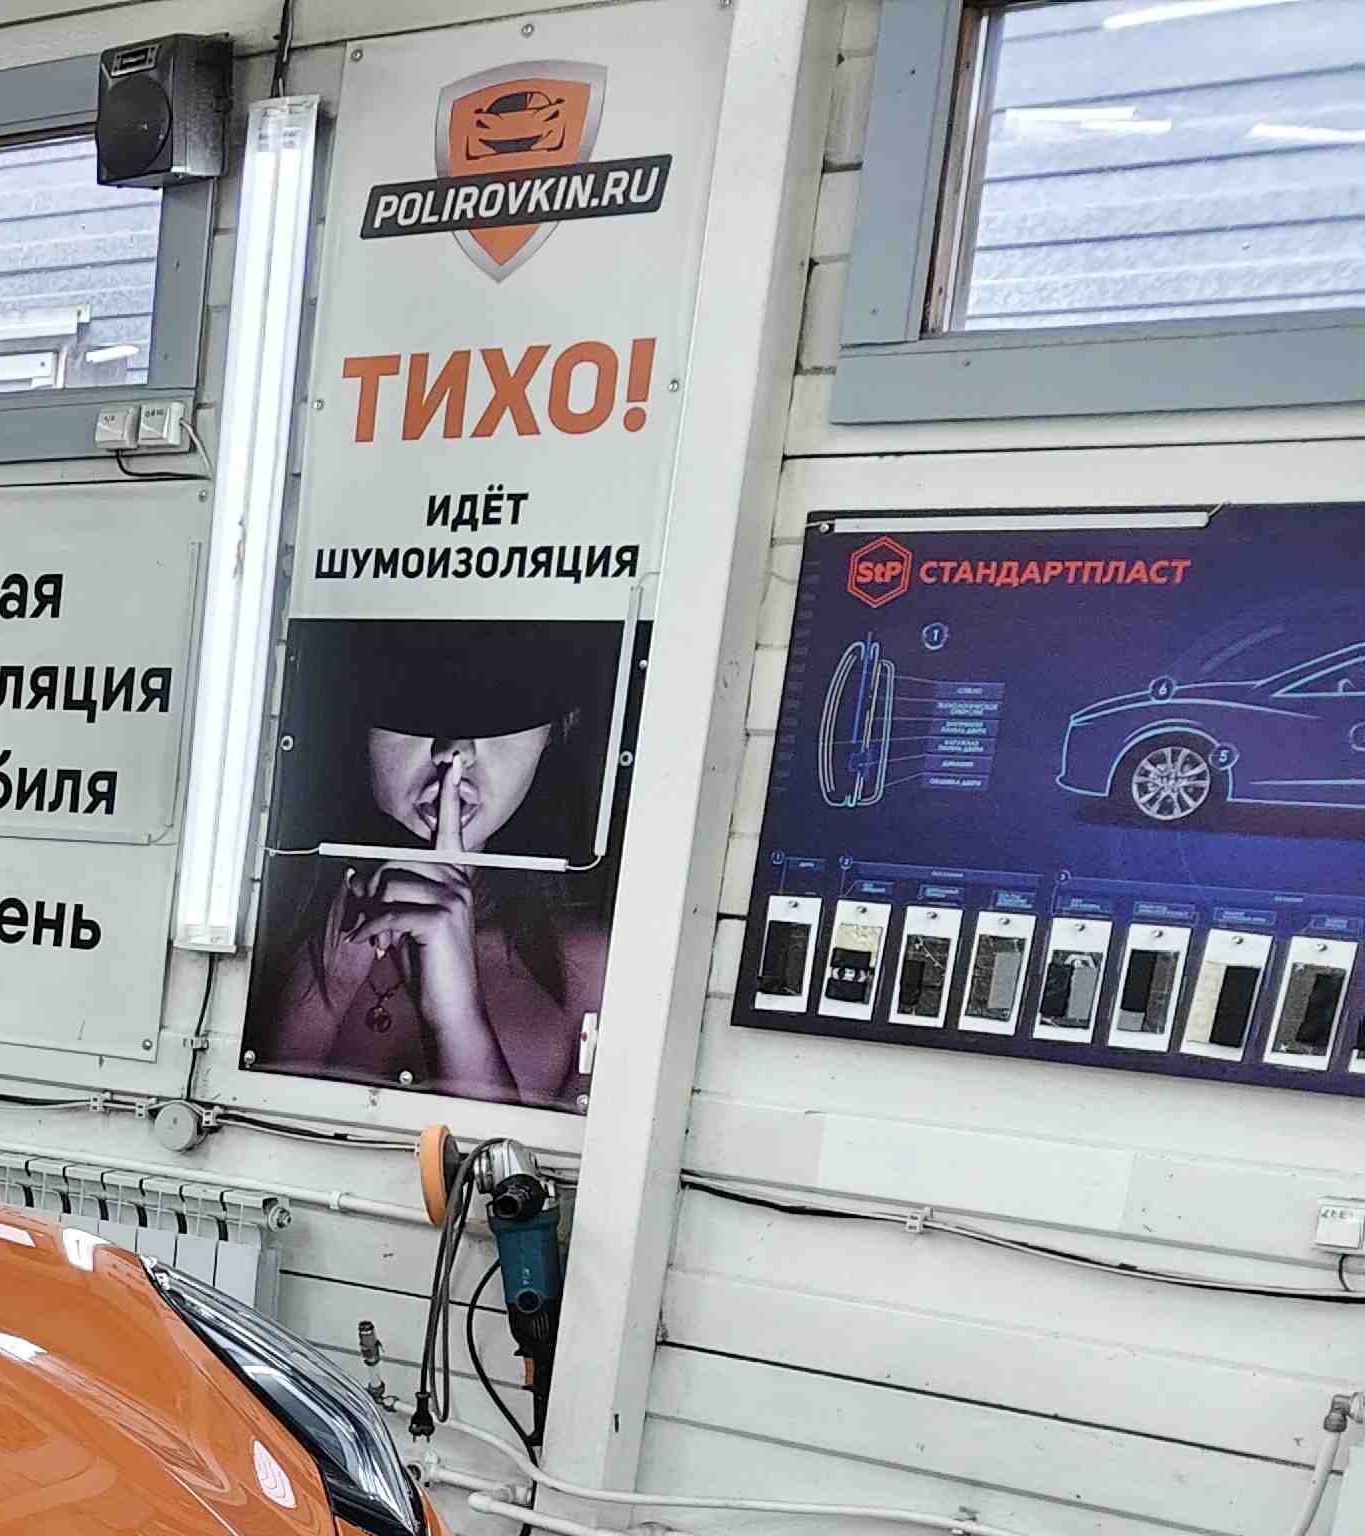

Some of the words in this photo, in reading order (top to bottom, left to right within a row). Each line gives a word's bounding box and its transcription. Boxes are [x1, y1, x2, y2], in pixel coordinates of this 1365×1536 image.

[372, 166, 660, 229] POLIROVKIN.RU
[342, 337, 657, 443] ТИХО!
[425, 483, 530, 533] ИДЁТ
[314, 544, 641, 585] ШУМОИЗОЛЯЦИЯ
[855, 561, 902, 584] StP
[918, 559, 1192, 587] СТАНДАРТПЛАСТ
